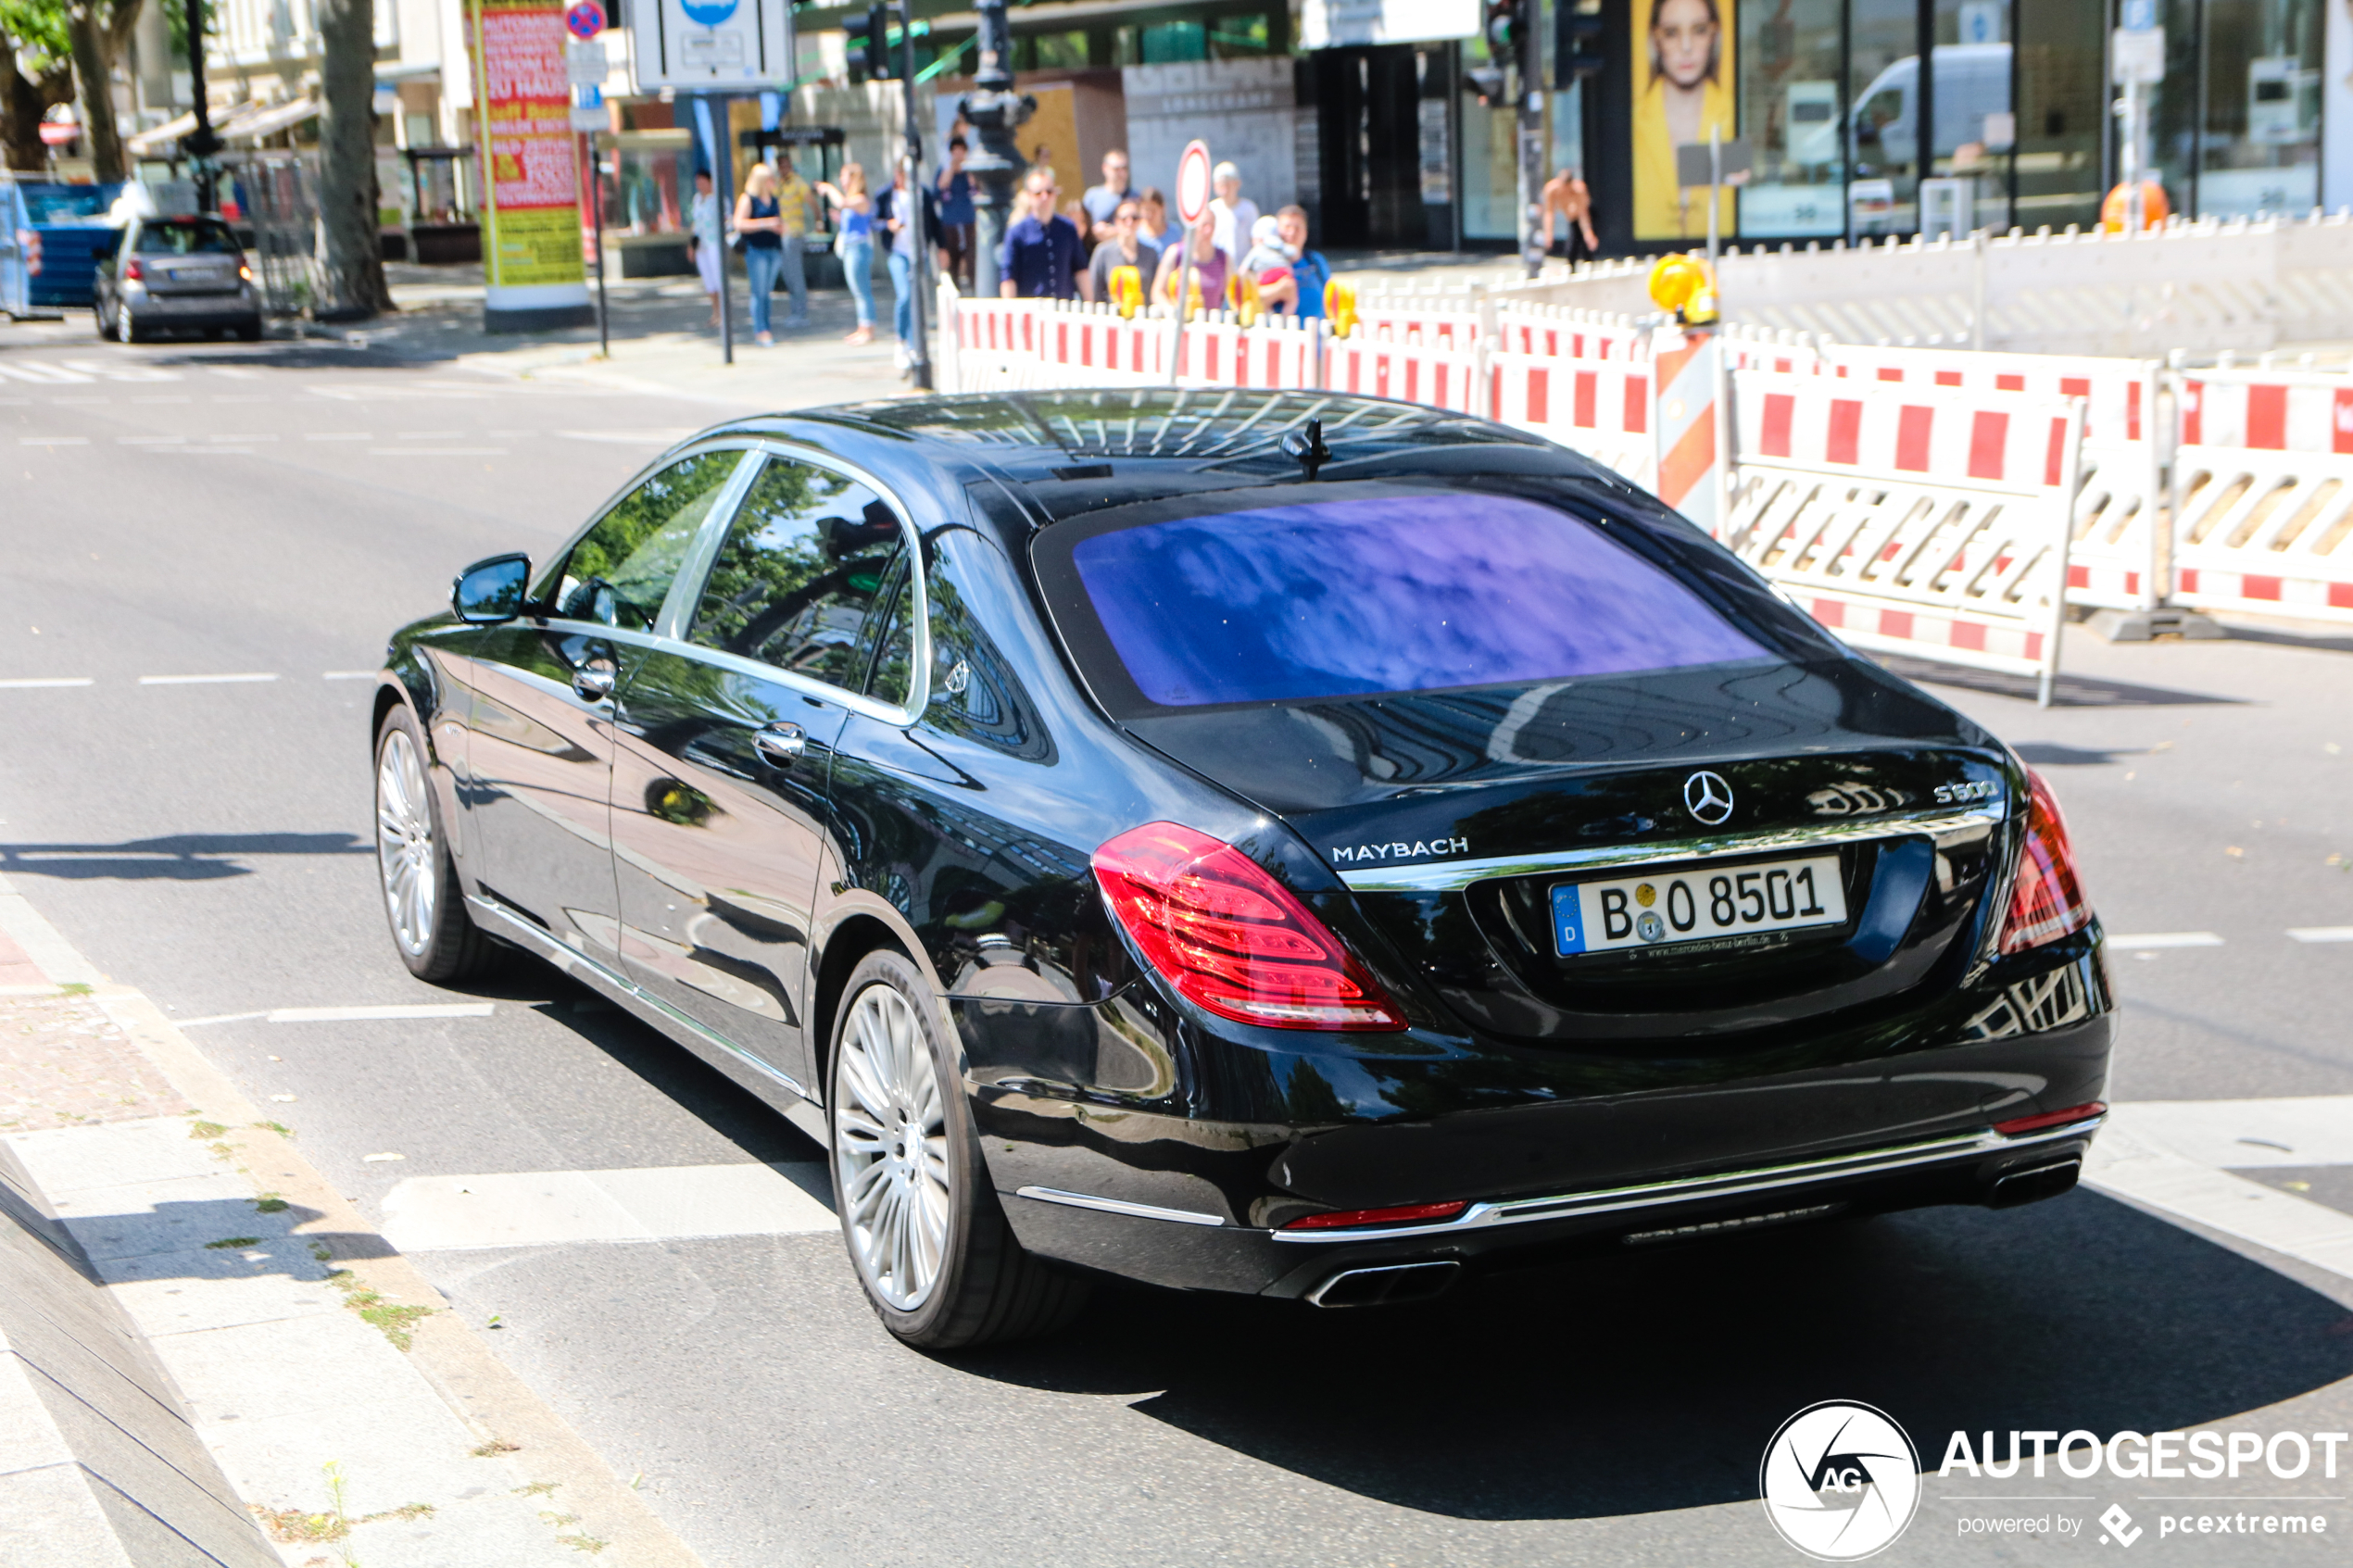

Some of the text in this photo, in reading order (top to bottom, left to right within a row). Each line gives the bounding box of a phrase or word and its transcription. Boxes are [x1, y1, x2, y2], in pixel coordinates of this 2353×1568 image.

[1332, 836, 1469, 863] MAYBACH
[1600, 867, 1825, 940] B O 8501
[1564, 926, 1577, 942] D
[1647, 934, 1771, 959] www.mercedes-benz-berlin.de
